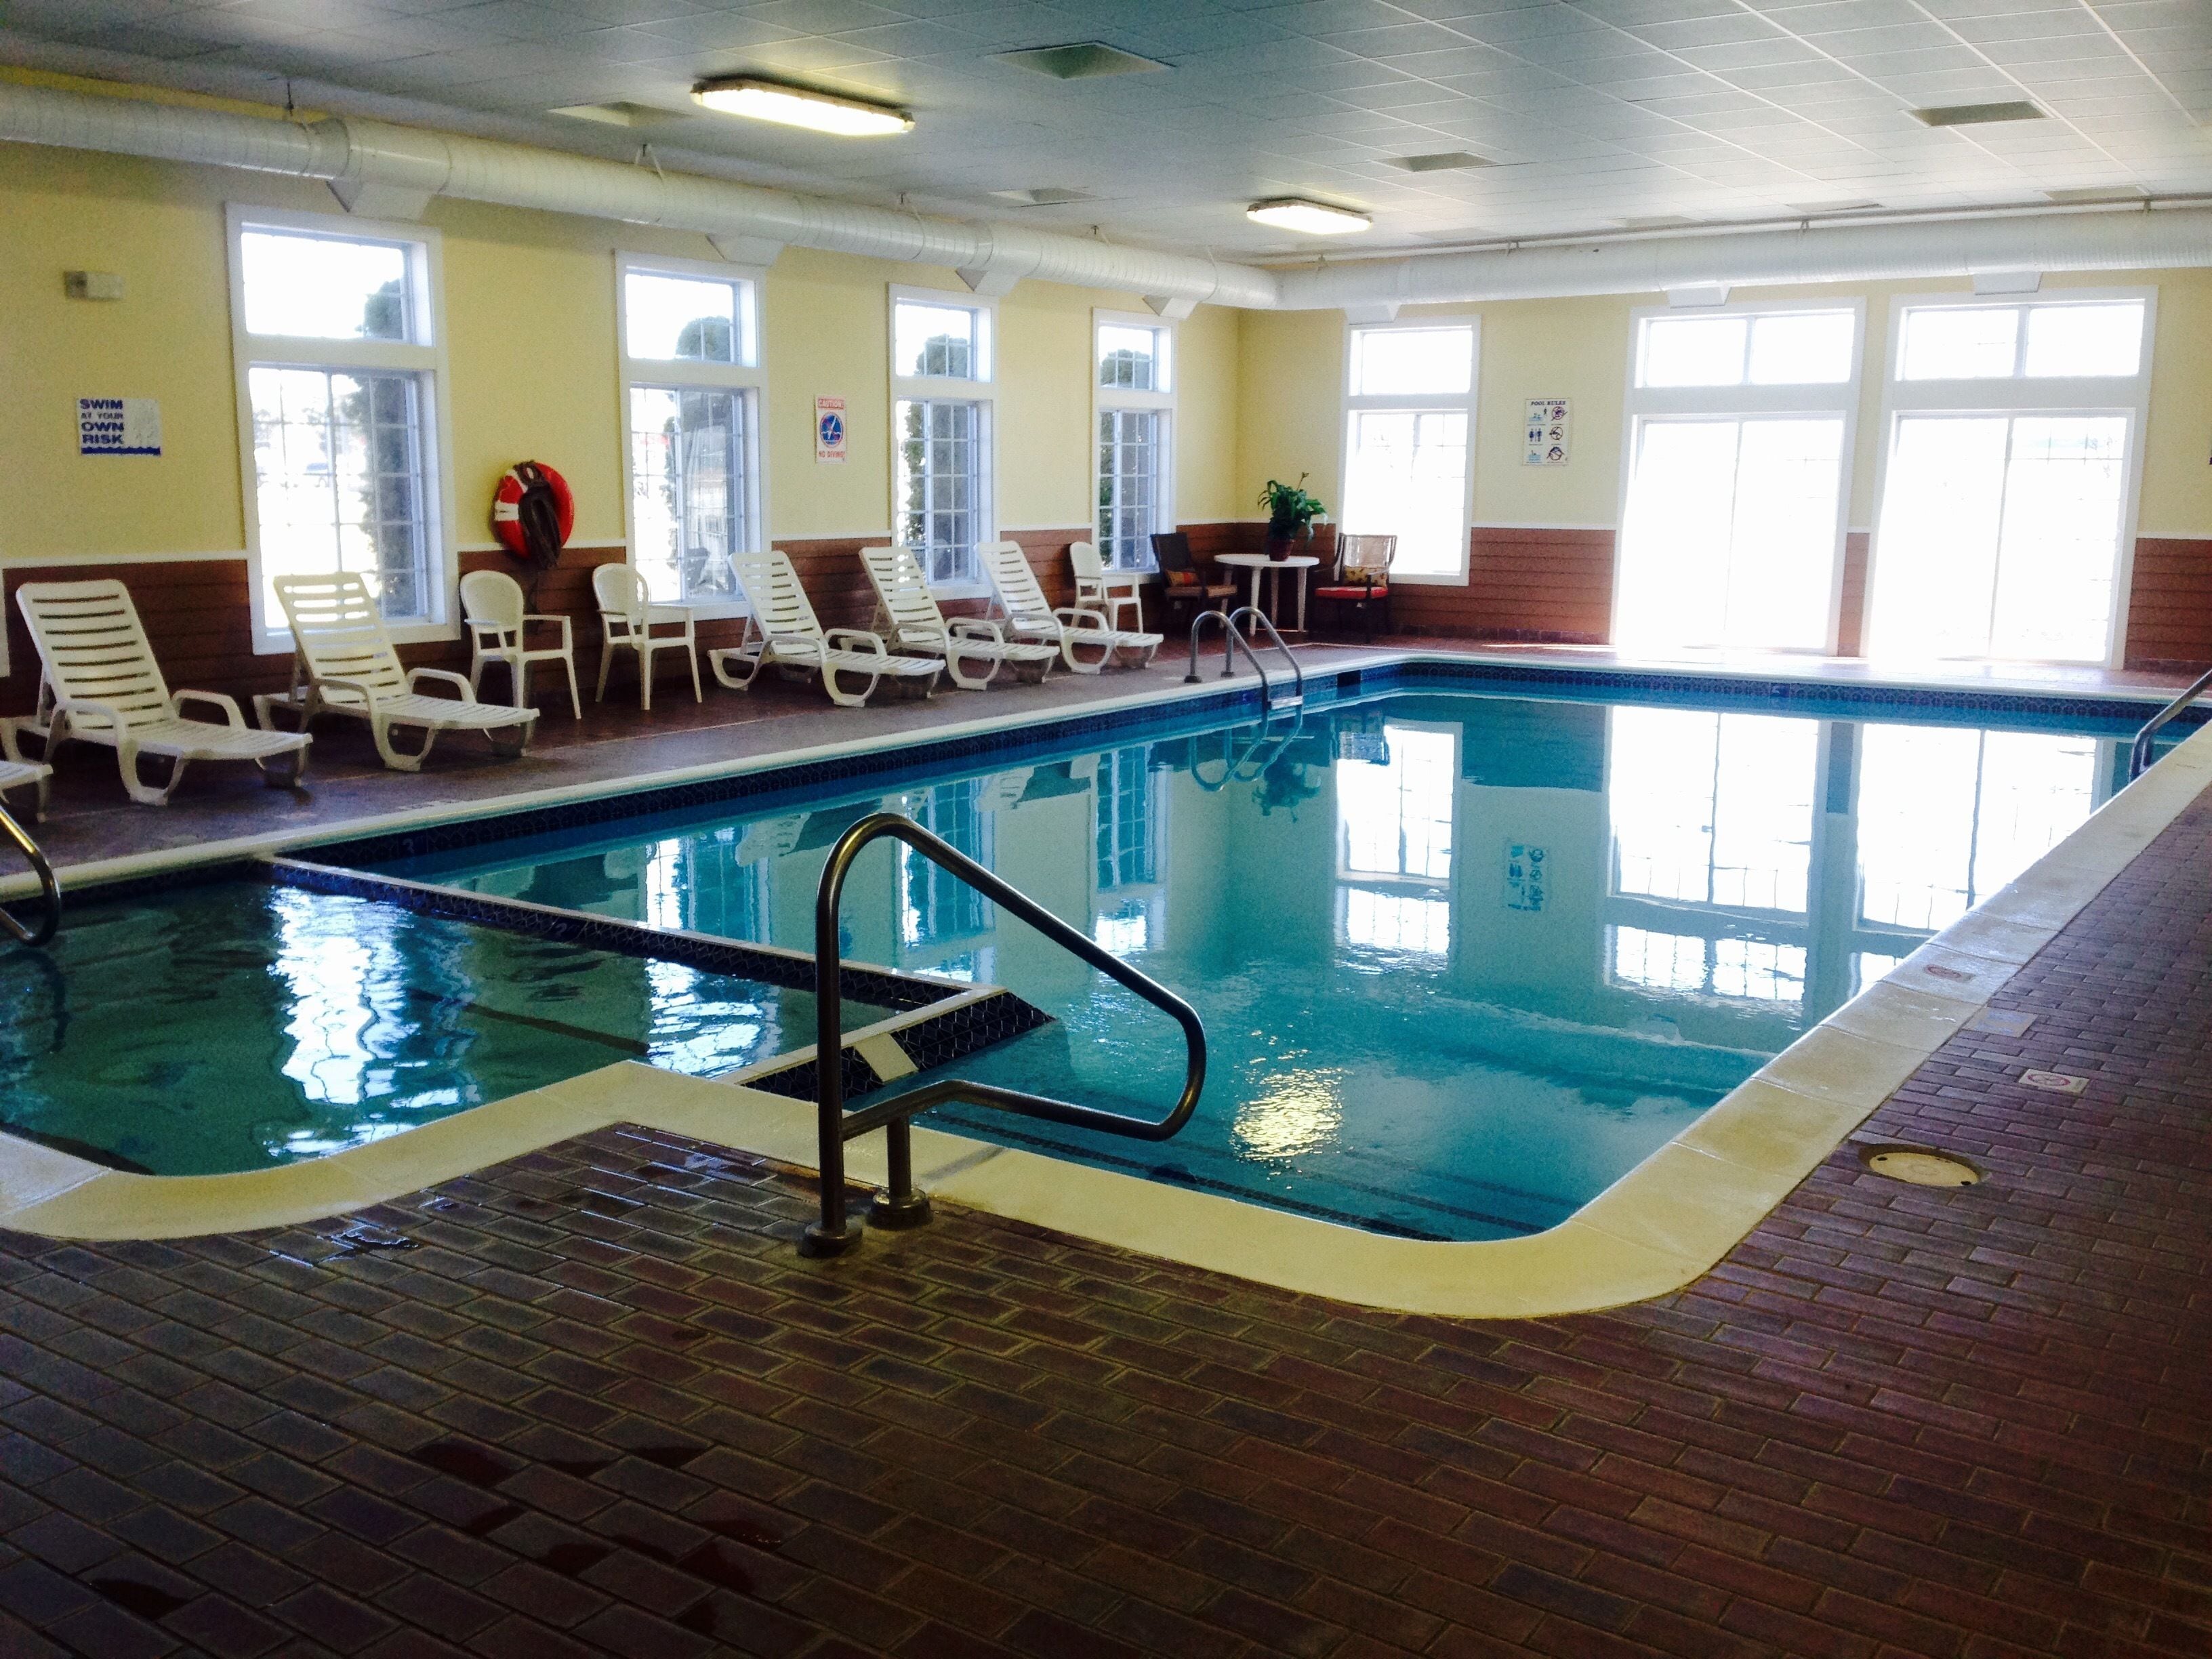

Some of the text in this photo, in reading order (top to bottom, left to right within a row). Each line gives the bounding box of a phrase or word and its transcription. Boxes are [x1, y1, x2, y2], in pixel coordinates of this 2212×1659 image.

[80, 398, 123, 409] SWIM
[81, 422, 124, 432] OWN
[82, 434, 123, 445] RISK
[819, 450, 825, 458] NO
